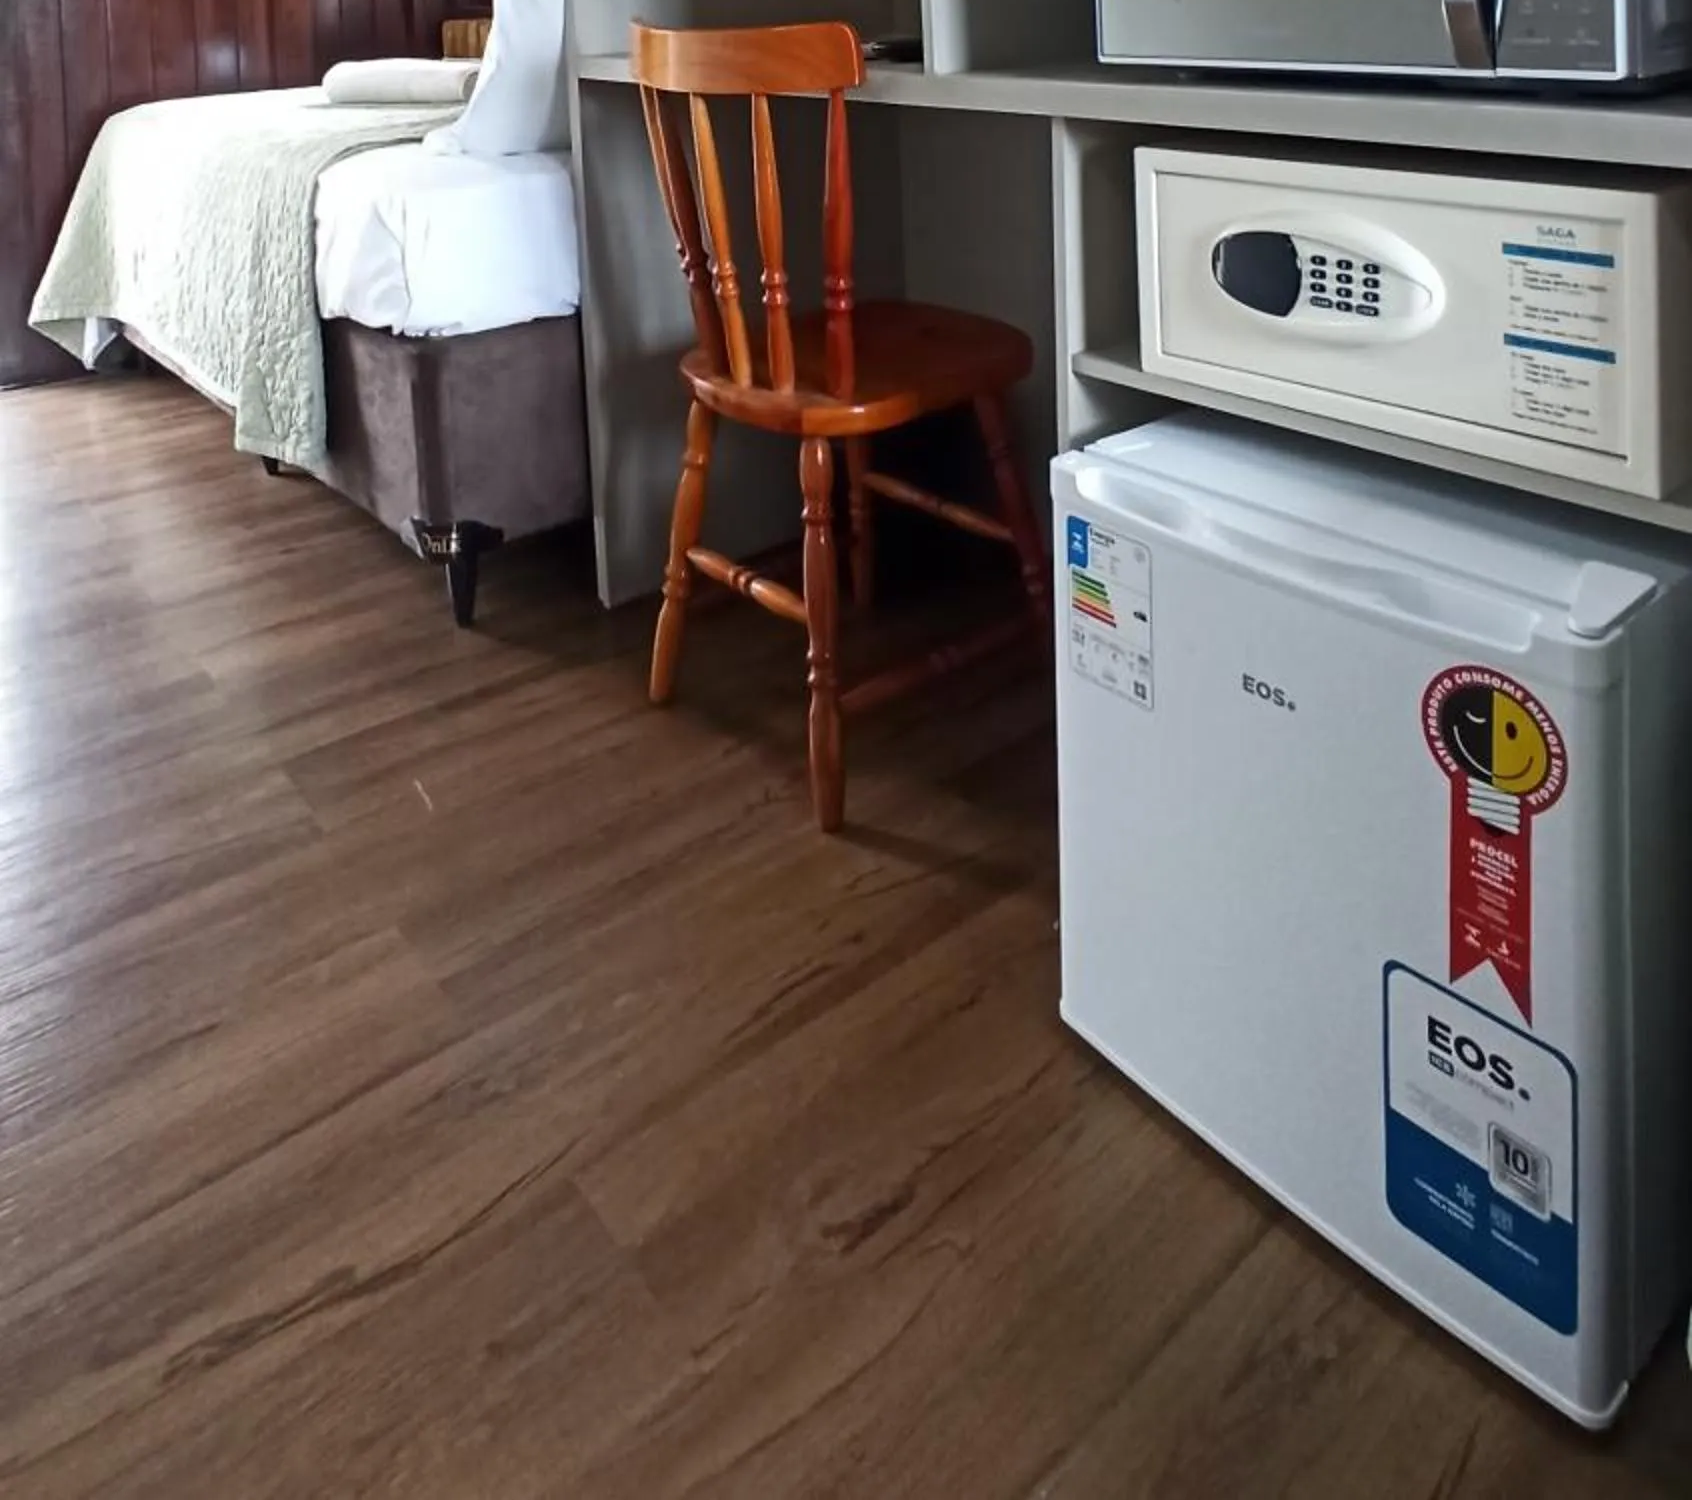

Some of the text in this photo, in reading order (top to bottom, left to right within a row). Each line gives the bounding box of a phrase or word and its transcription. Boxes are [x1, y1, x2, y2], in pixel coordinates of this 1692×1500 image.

[1536, 225, 1576, 239] SAGA
[1455, 671, 1524, 700] CONSOME
[1427, 677, 1453, 737] PRODUTO
[1525, 701, 1562, 754] MENOS
[1525, 758, 1564, 805] ENERGIA
[1469, 838, 1519, 869] PROCEL
[1501, 1139, 1530, 1176] 10
